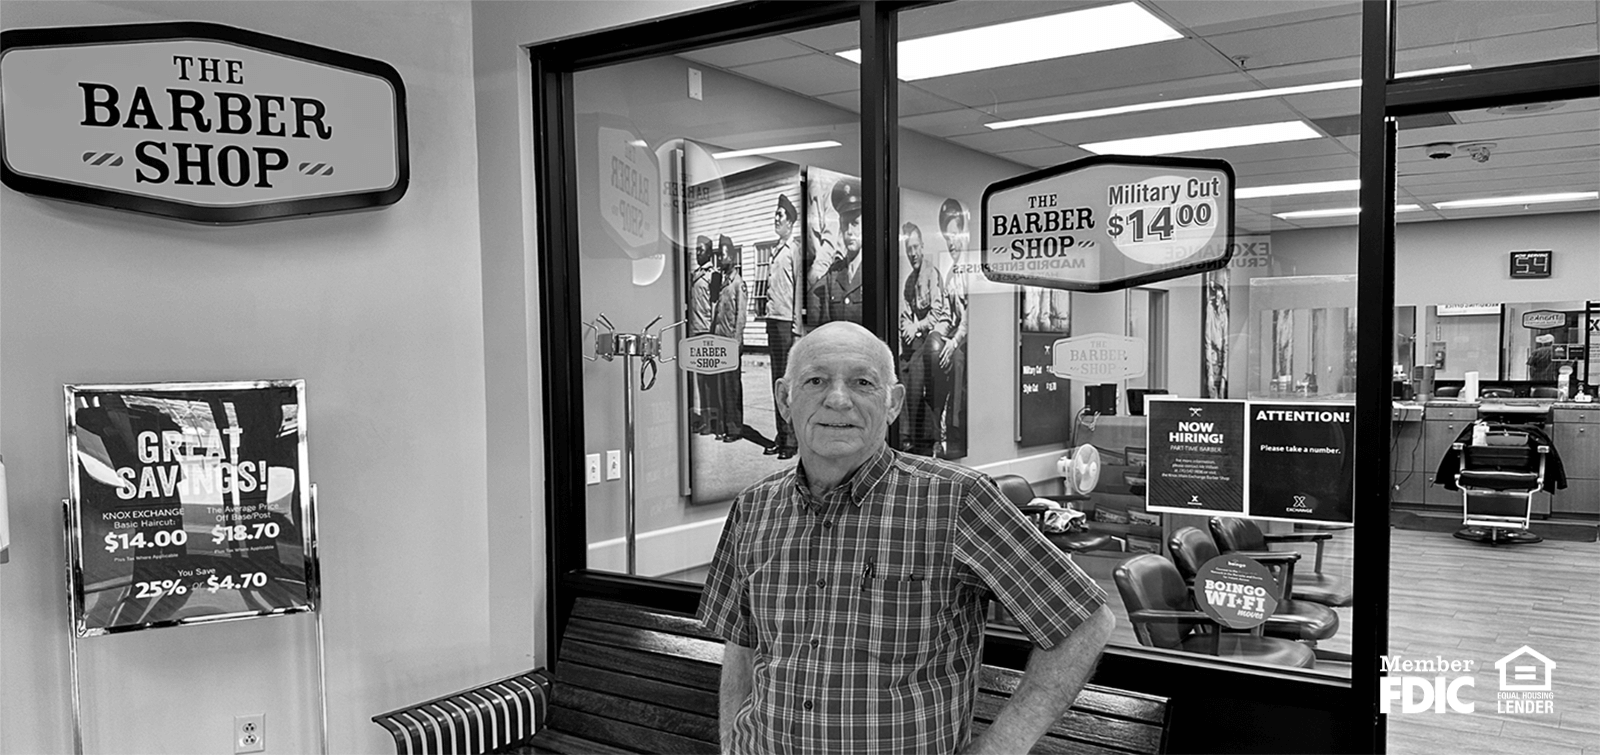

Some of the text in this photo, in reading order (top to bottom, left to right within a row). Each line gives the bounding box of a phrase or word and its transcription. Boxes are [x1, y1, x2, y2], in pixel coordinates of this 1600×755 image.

[173, 55, 244, 85] THE
[78, 82, 333, 140] BARBER
[135, 141, 289, 189] SHOP
[1108, 177, 1221, 207] Military Cut
[1028, 194, 1057, 209] THE
[992, 207, 1096, 237] BARBER
[1011, 235, 1075, 260] SHOP
[689, 347, 727, 357] BARBER
[1070, 349, 1128, 361] BARBER
[696, 358, 721, 368] SHOP
[1080, 363, 1116, 375] SHOP
[1256, 410, 1351, 423] ATTENTION!
[1178, 421, 1215, 433] NOW
[1169, 431, 1224, 444] HIRING!
[137, 428, 244, 463] GREAT
[1260, 444, 1285, 453] Please
[1286, 445, 1302, 453] take
[1309, 446, 1342, 455] number.
[115, 460, 267, 500] SAVINGS!
[102, 507, 185, 520] KNOX EXCHANGE
[206, 502, 279, 514] The Average Price
[114, 518, 176, 529] Basic Haircut:
[215, 511, 272, 522] Off Base/Post
[211, 521, 281, 545] $18.70
[104, 529, 188, 553] $14.00
[177, 567, 217, 577] You Save
[135, 571, 268, 600] 25% or $4.70
[1205, 579, 1266, 597] BOINGO
